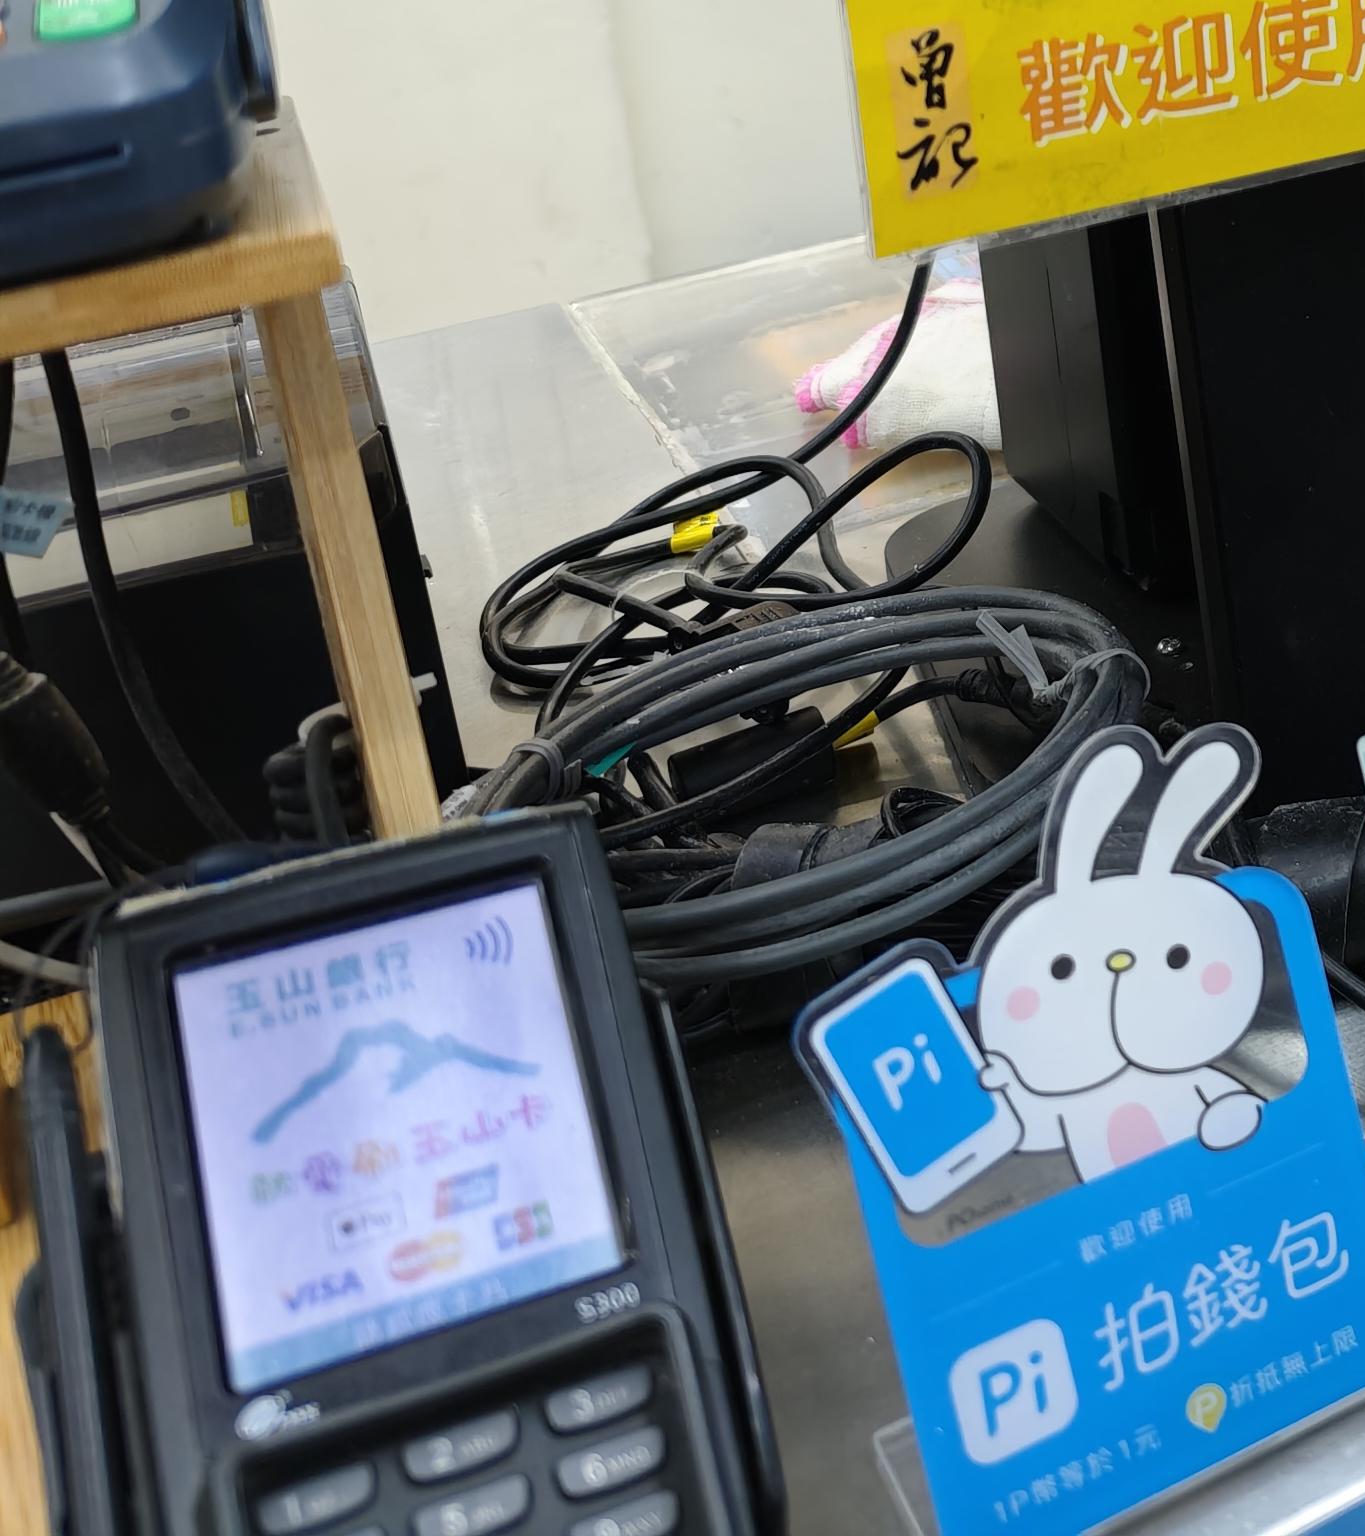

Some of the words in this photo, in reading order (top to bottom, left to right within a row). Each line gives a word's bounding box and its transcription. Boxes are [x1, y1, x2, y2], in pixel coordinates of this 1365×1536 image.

[872, 1032, 943, 1112] Pi
[1078, 1193, 1194, 1265] 歡迎使用
[280, 1269, 366, 1315] VISA
[976, 1349, 1050, 1439] Pi
[1094, 1210, 1351, 1393] 拍錢包
